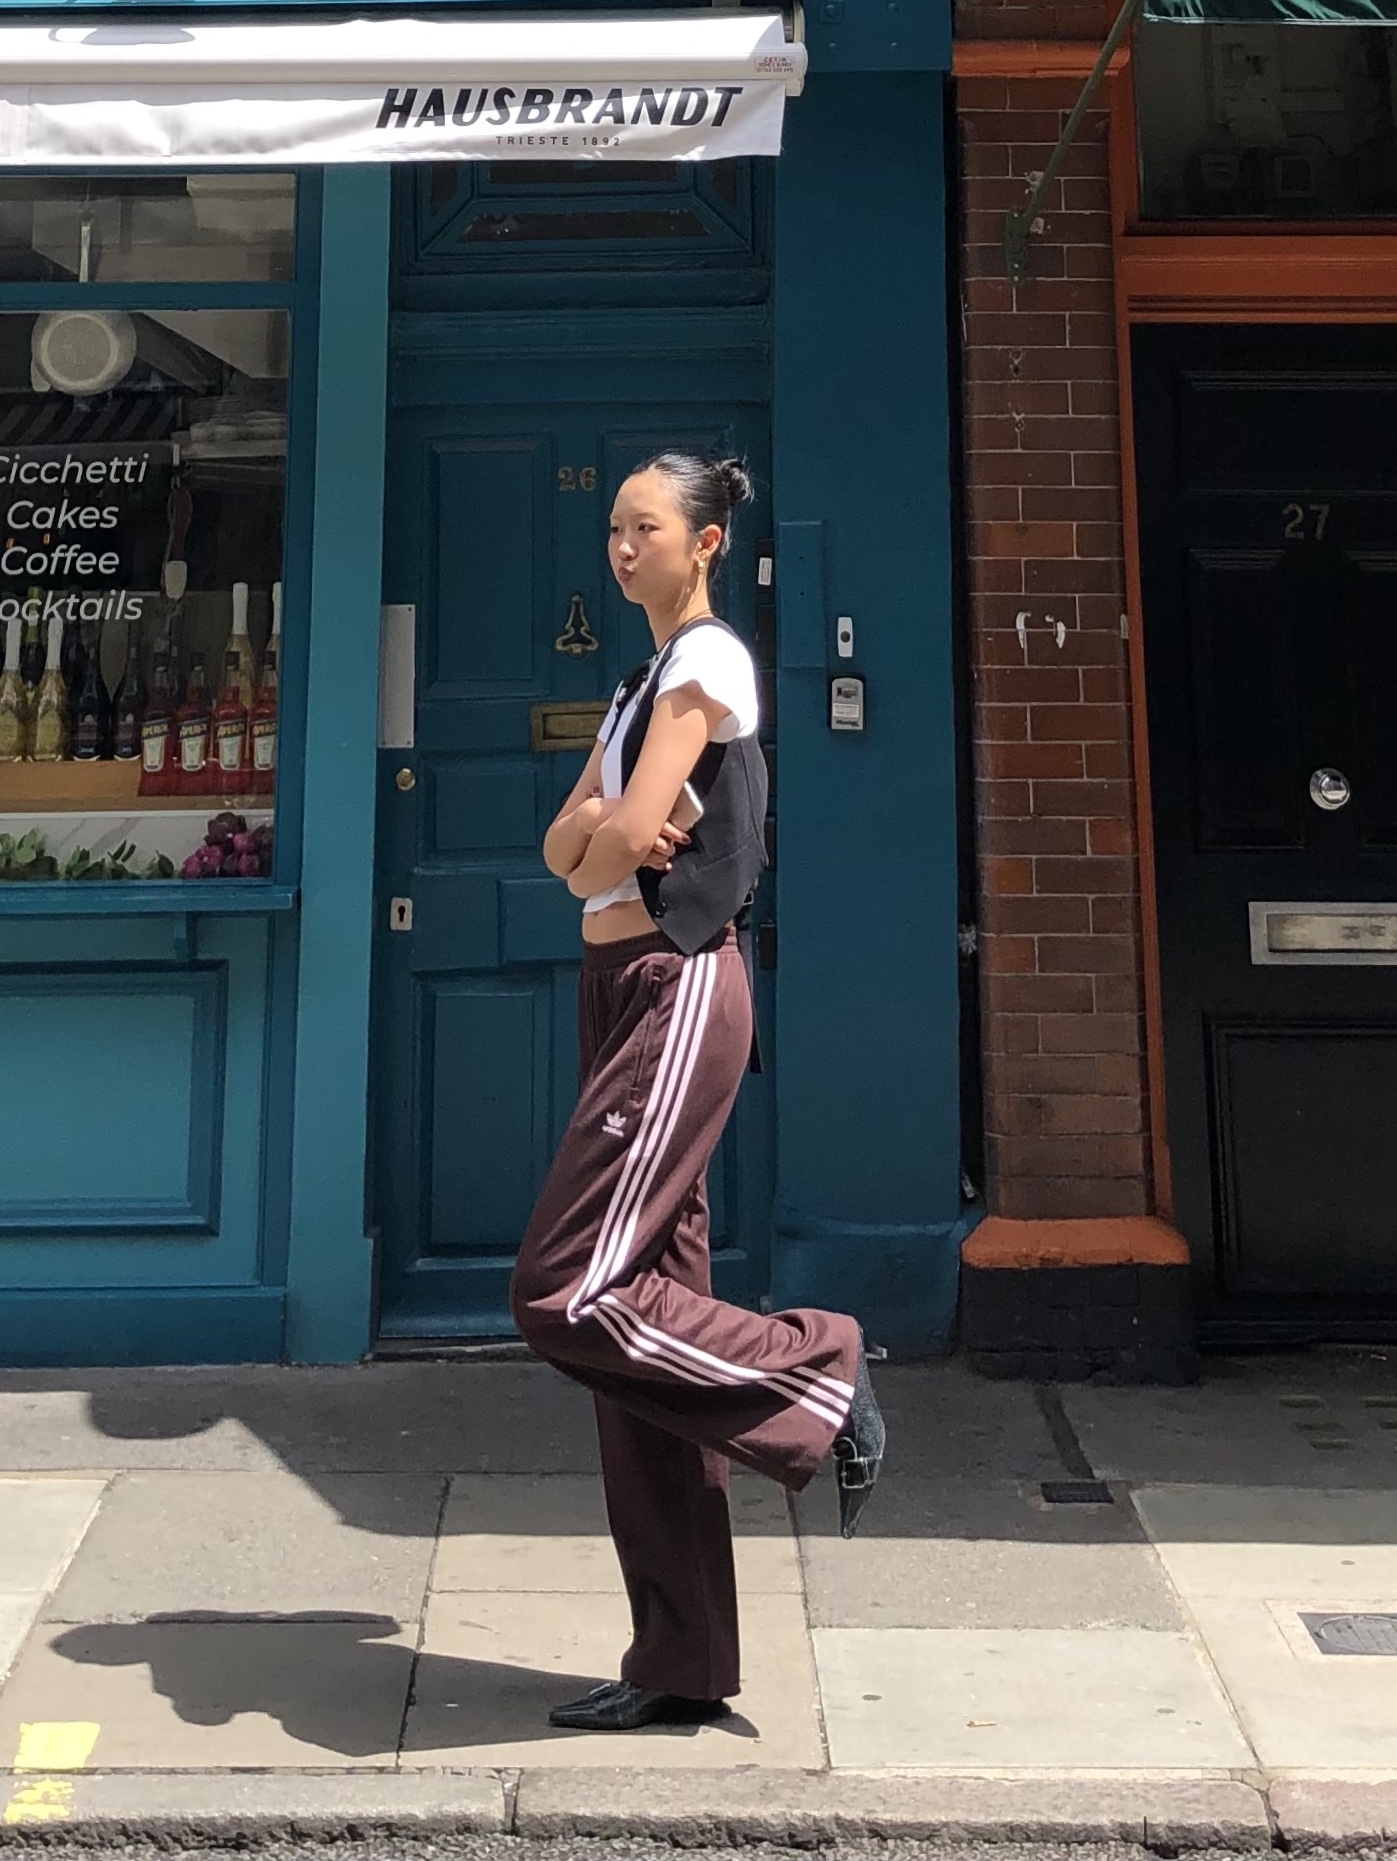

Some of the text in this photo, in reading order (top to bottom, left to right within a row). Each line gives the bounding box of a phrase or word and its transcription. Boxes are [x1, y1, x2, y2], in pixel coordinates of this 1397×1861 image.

[375, 86, 744, 129] HAUSBRANDT
[496, 136, 620, 147] TRIESTE 1892
[558, 466, 596, 491] 26
[6, 498, 119, 530] Cakes
[1283, 503, 1330, 540] 27
[1, 544, 120, 576] Coffee
[0, 589, 144, 622] ocktails
